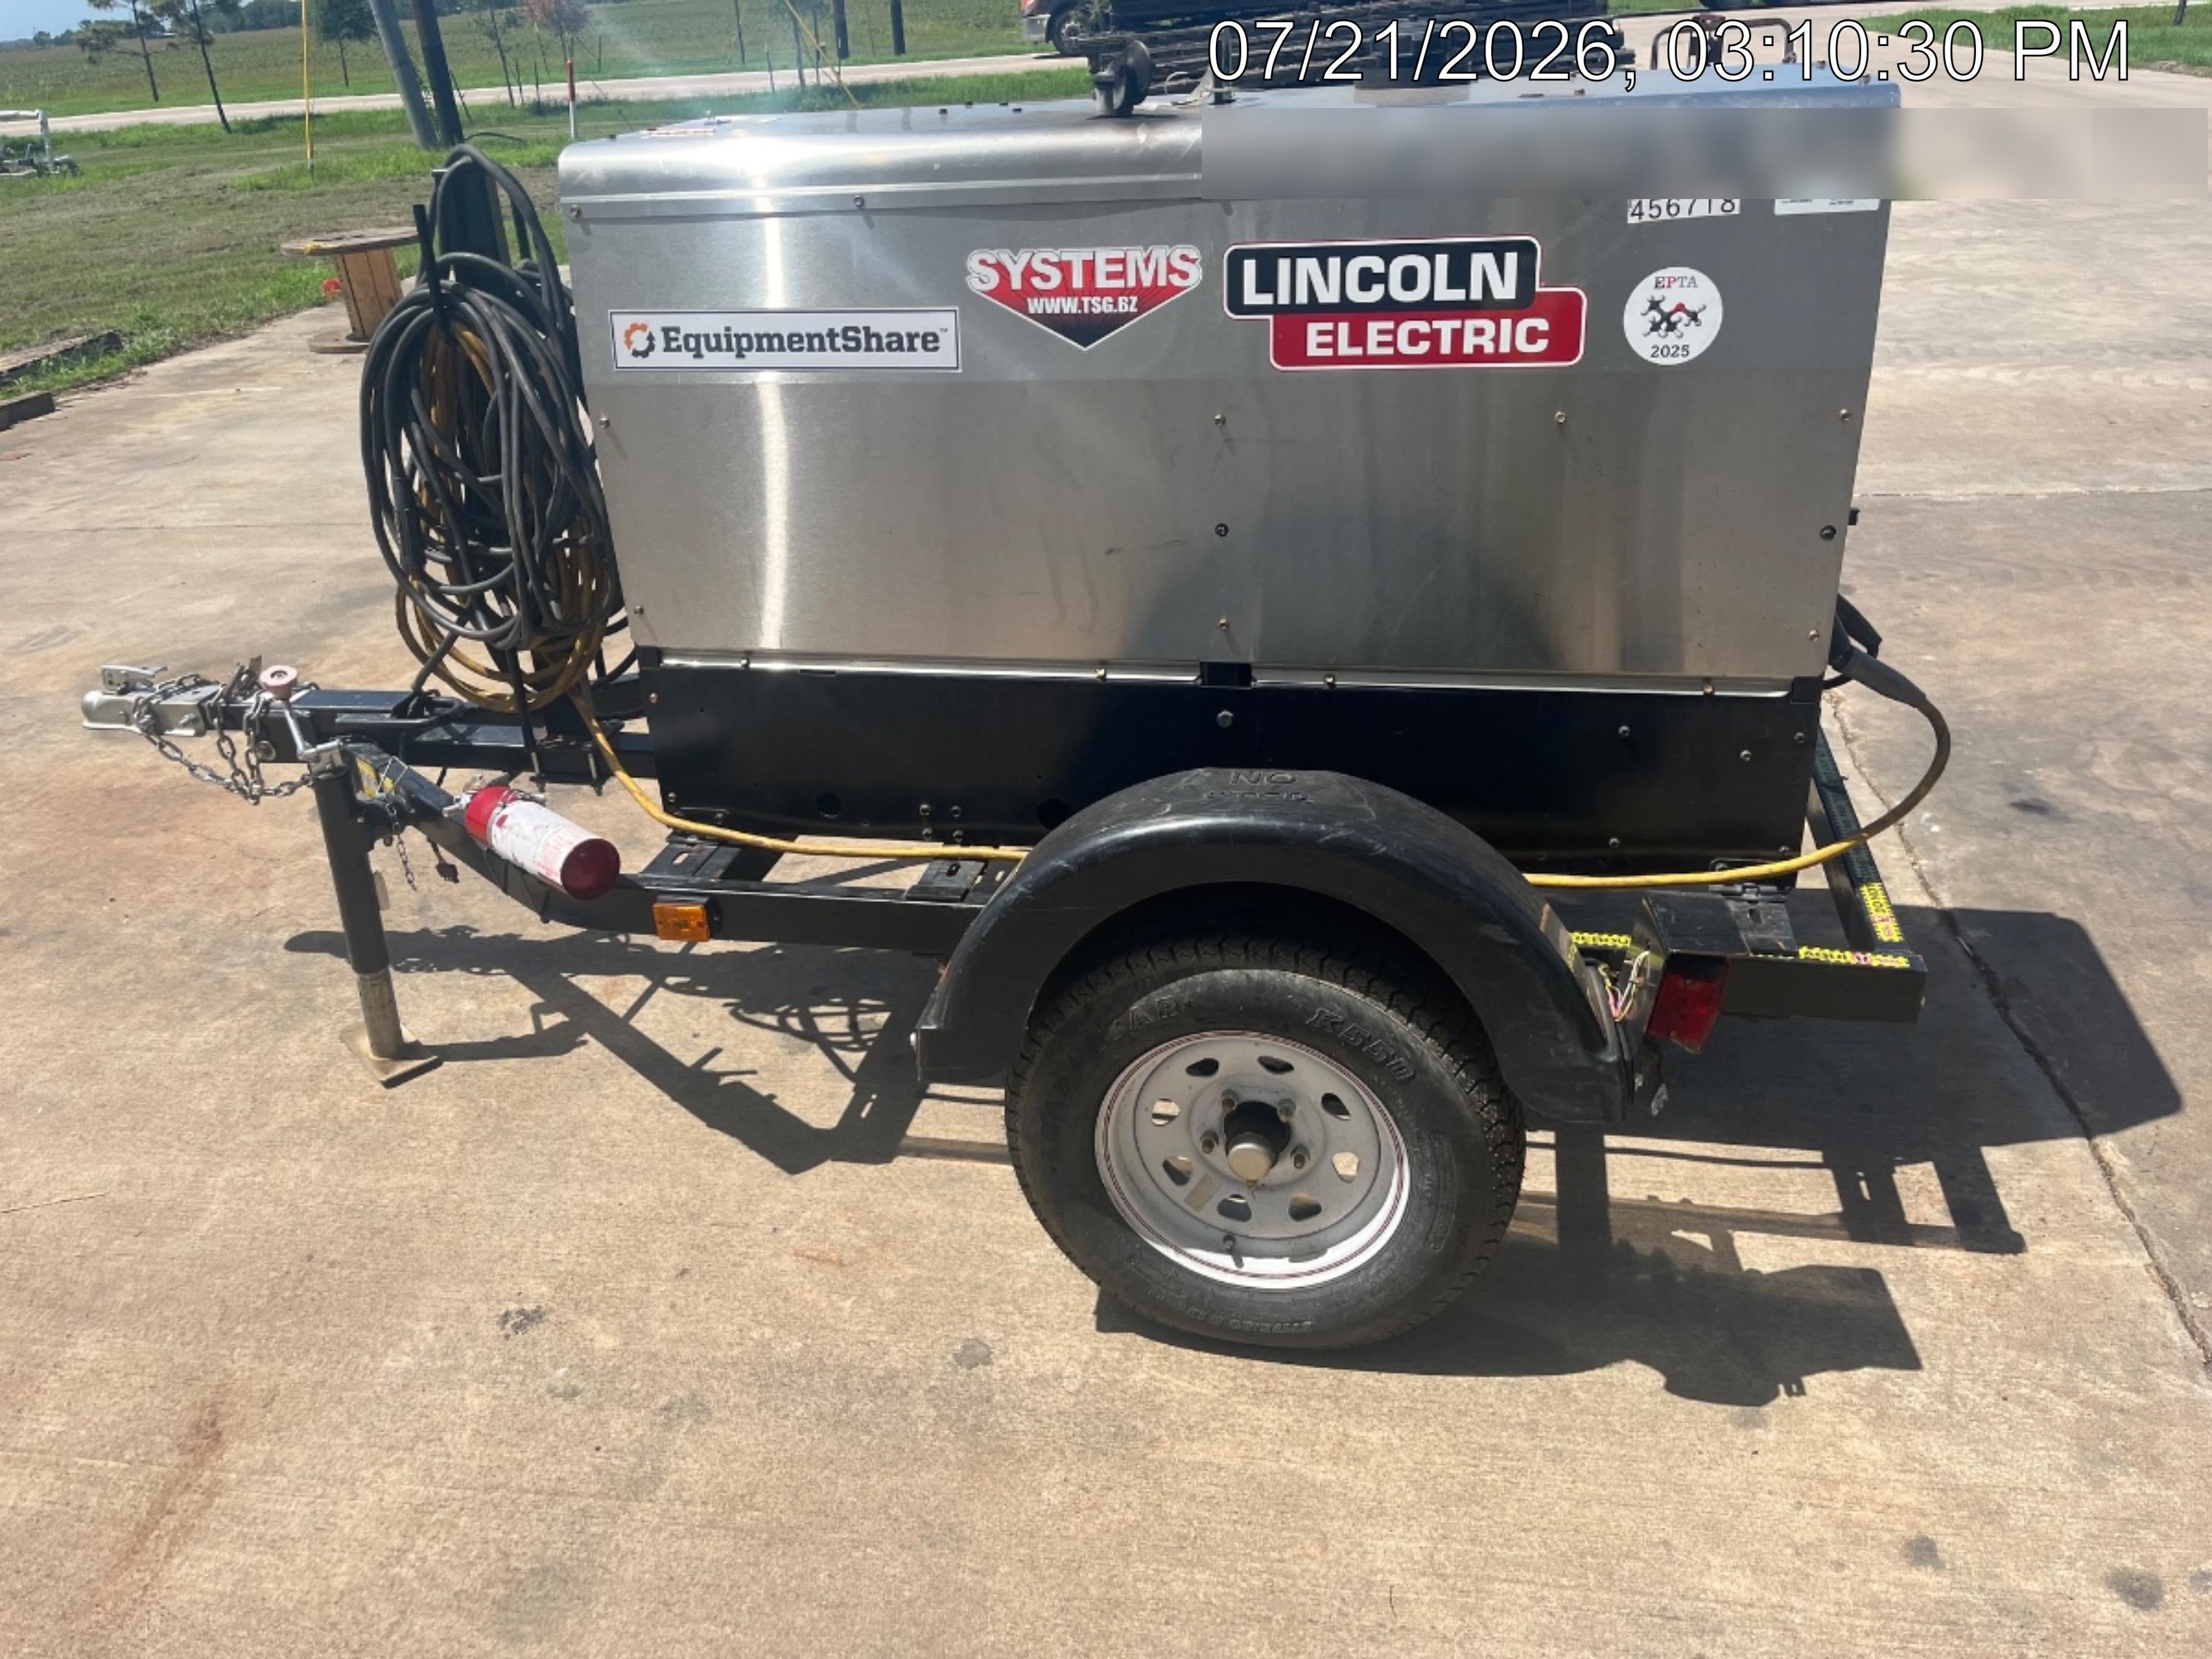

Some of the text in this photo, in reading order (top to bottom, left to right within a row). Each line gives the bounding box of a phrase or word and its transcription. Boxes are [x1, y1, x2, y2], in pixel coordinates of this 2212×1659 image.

[966, 246, 1202, 292] SYSTEMS
[1242, 251, 1518, 305] LINCOLN
[1653, 275, 1698, 289] EPTA
[1027, 296, 1138, 314] WWW.TSG.BZ
[661, 326, 940, 359] EquipmentShare
[1306, 318, 1549, 356] ELECTRIC
[1650, 344, 1690, 358] 2025
